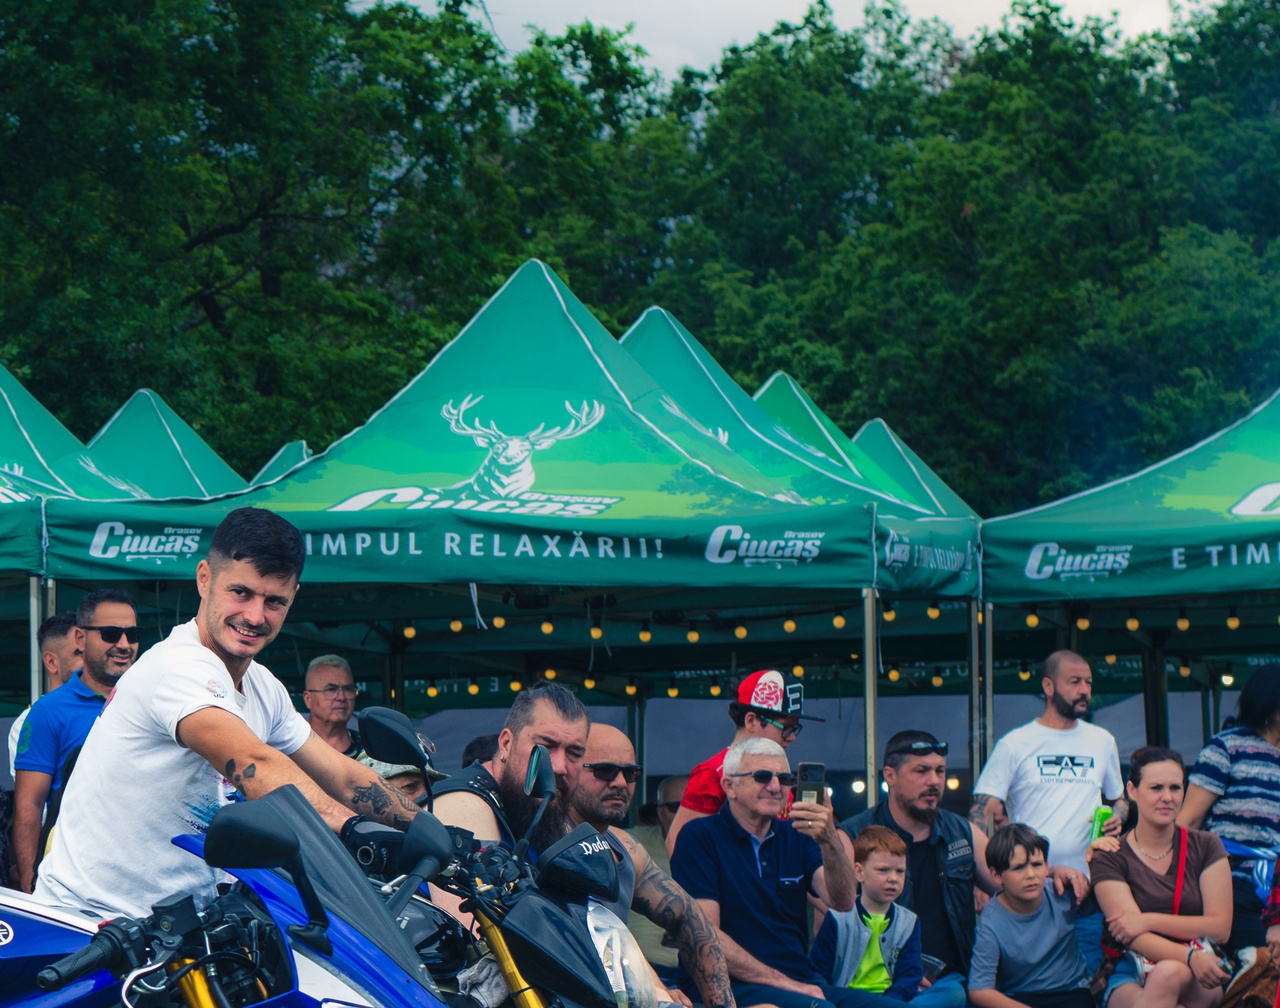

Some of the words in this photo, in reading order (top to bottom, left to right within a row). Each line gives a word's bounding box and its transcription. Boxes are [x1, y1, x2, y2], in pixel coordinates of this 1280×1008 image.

[304, 532, 423, 556] IMPUL
[444, 530, 664, 560] RELAXĂRII!
[1172, 547, 1187, 569] E
[1205, 541, 1280, 568] TIM
